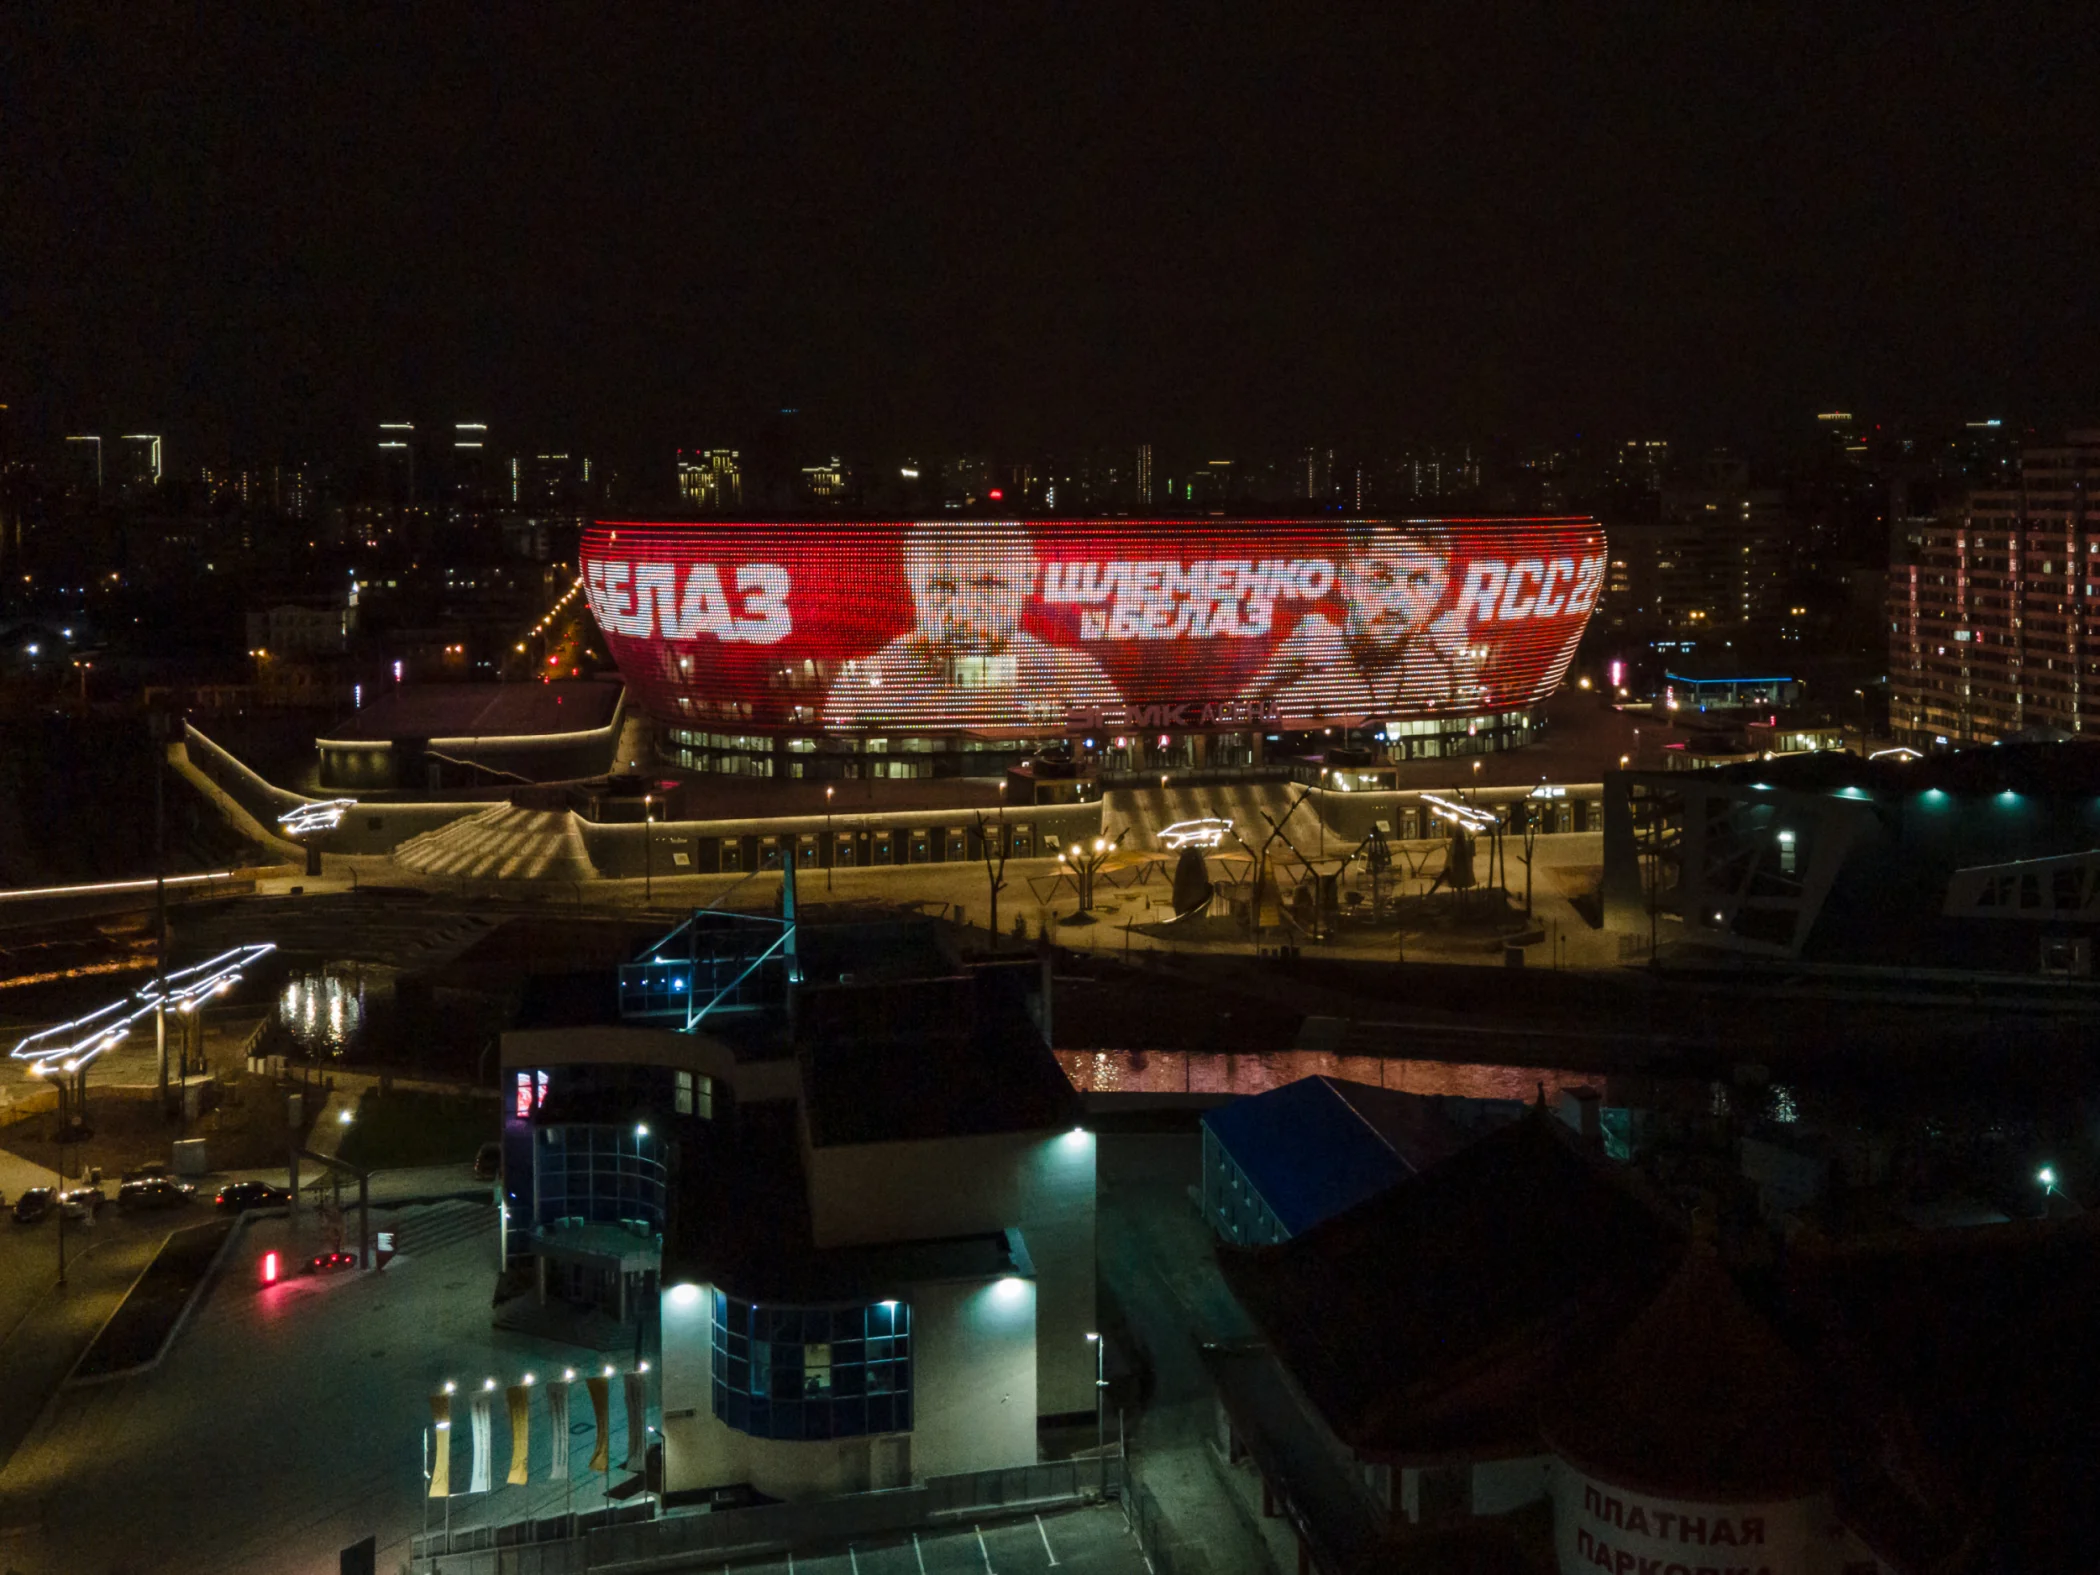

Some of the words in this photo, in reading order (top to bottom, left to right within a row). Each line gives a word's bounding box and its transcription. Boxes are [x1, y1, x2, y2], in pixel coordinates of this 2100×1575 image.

[1043, 559, 1335, 602] ШЛЕМЕНКО
[1109, 600, 1274, 640] БЕЛАЗ
[1199, 702, 1283, 726] АРЕНА
[1585, 1484, 1765, 1546] ПЛАТНАЯ
